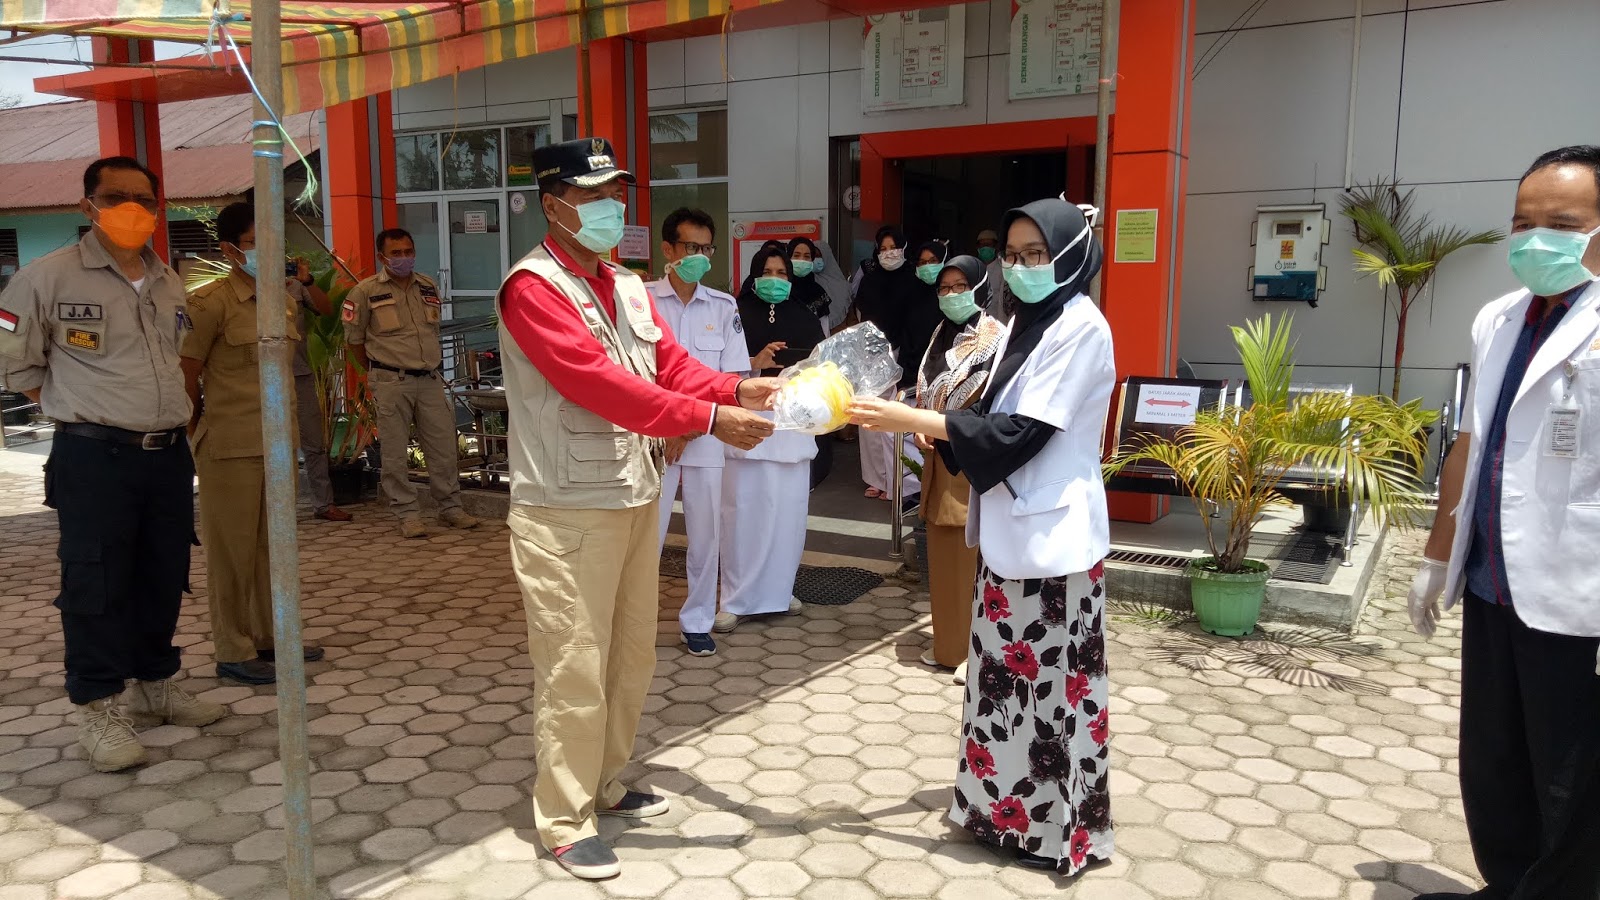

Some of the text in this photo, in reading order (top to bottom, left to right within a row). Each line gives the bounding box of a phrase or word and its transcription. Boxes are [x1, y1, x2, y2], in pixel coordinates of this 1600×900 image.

[1021, 14, 1029, 53] RUANGAN
[68, 306, 93, 318] J.A
[70, 337, 95, 347] RESCUE
[75, 332, 91, 341] FIRE
